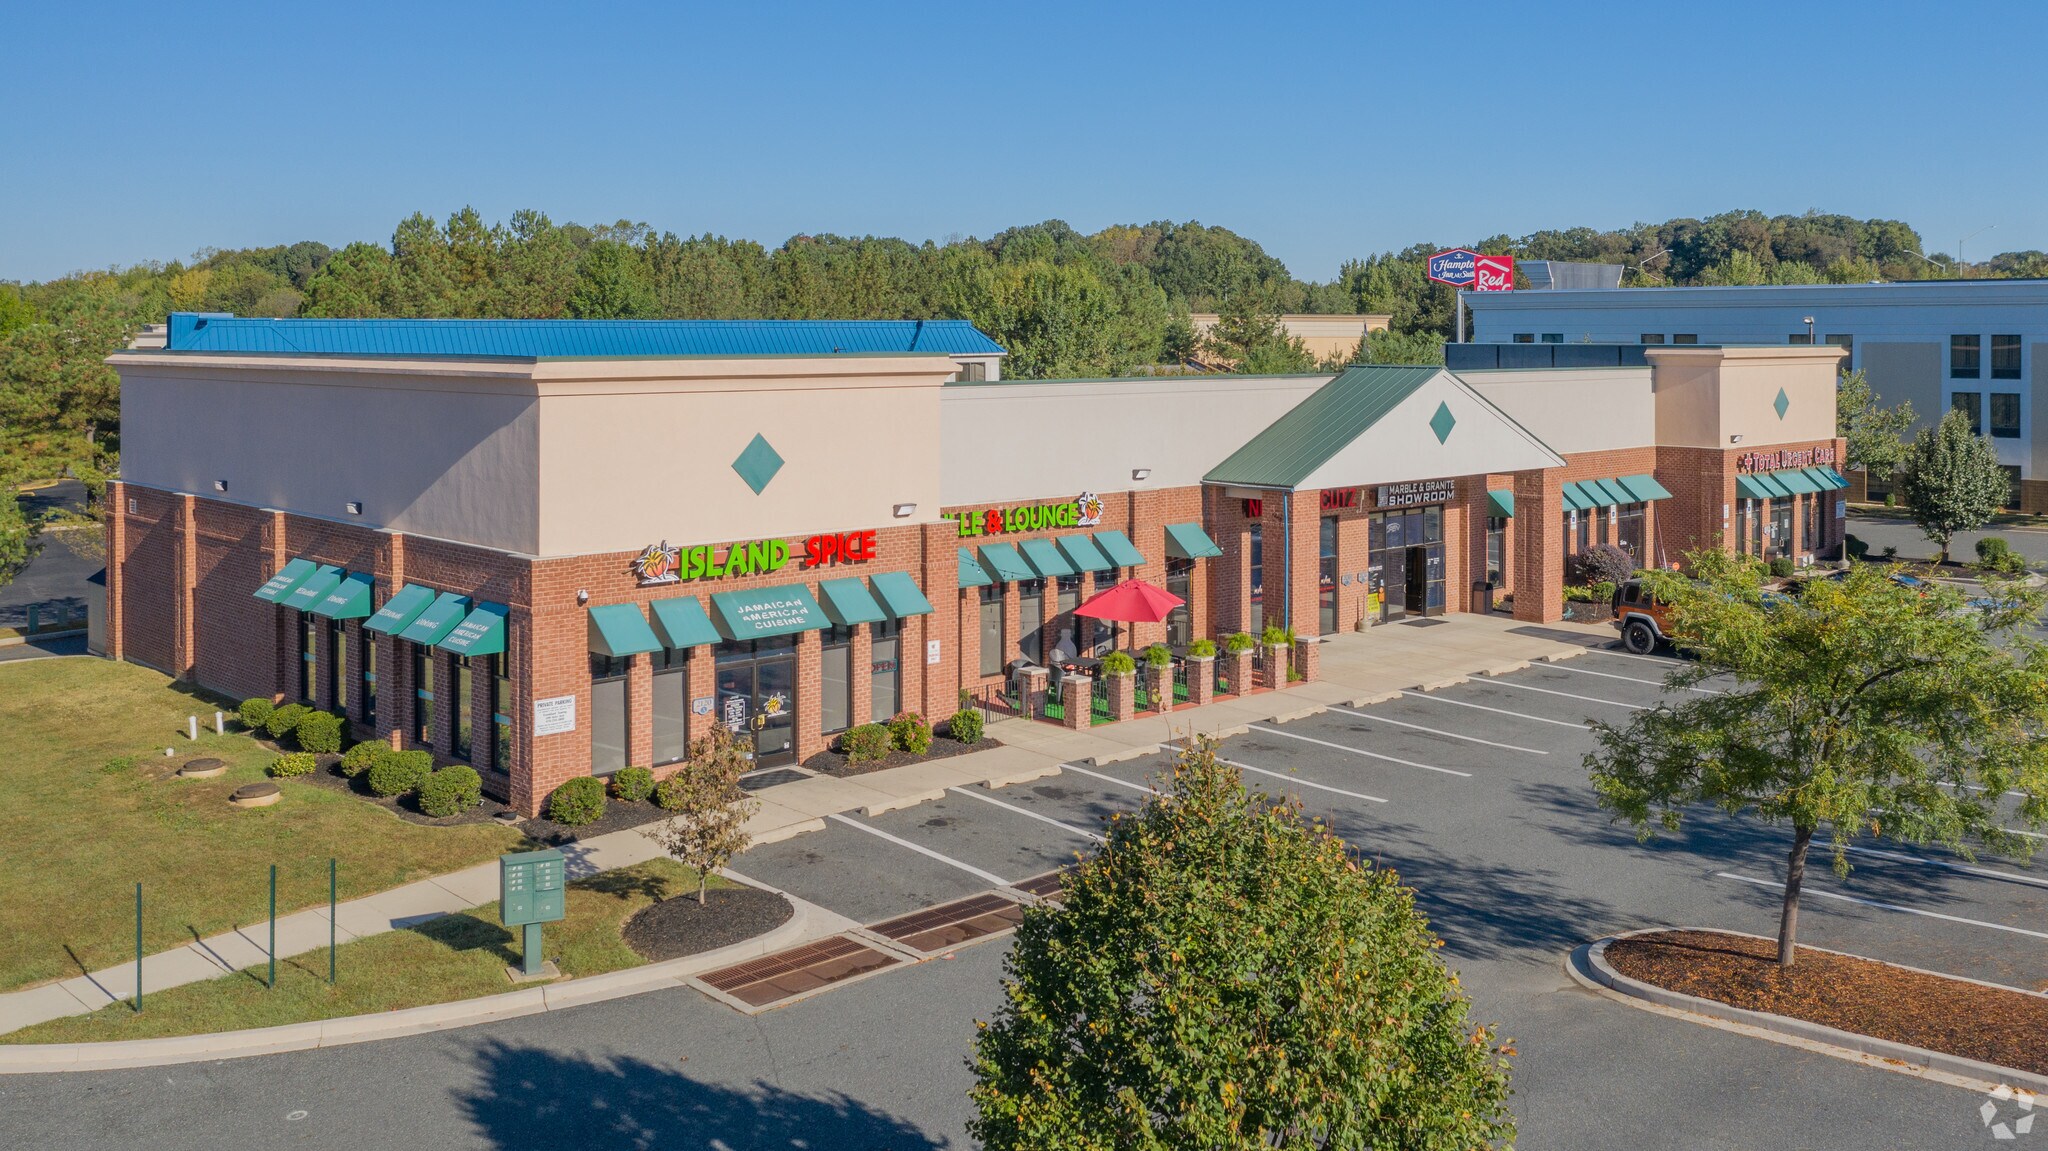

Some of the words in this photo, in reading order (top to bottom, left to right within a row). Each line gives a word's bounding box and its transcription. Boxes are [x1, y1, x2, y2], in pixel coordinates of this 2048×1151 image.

[1434, 259, 1474, 272] Hampto
[1438, 271, 1455, 279] Inn
[1479, 270, 1505, 286] Red
[1389, 483, 1417, 495] MARBLE
[1419, 482, 1424, 492] &
[1426, 480, 1455, 491] GRANITE
[1320, 487, 1357, 510] CUTZ
[1389, 490, 1455, 506] SHOWROOM
[987, 509, 1003, 533] &
[1005, 502, 1079, 532] LOUNGE
[681, 539, 790, 580] ISLAND
[806, 529, 877, 567] SPICE
[737, 599, 803, 615] JAMAICAN
[742, 607, 809, 622] AMERICAN
[415, 618, 440, 629] DINING
[461, 621, 490, 632] JAMAICAN
[755, 616, 807, 630] CUISINE
[453, 628, 482, 640] AMERICAN
[448, 636, 471, 647] CUISINE
[537, 700, 553, 708] PRIVATE
[554, 698, 572, 706] PARKING
